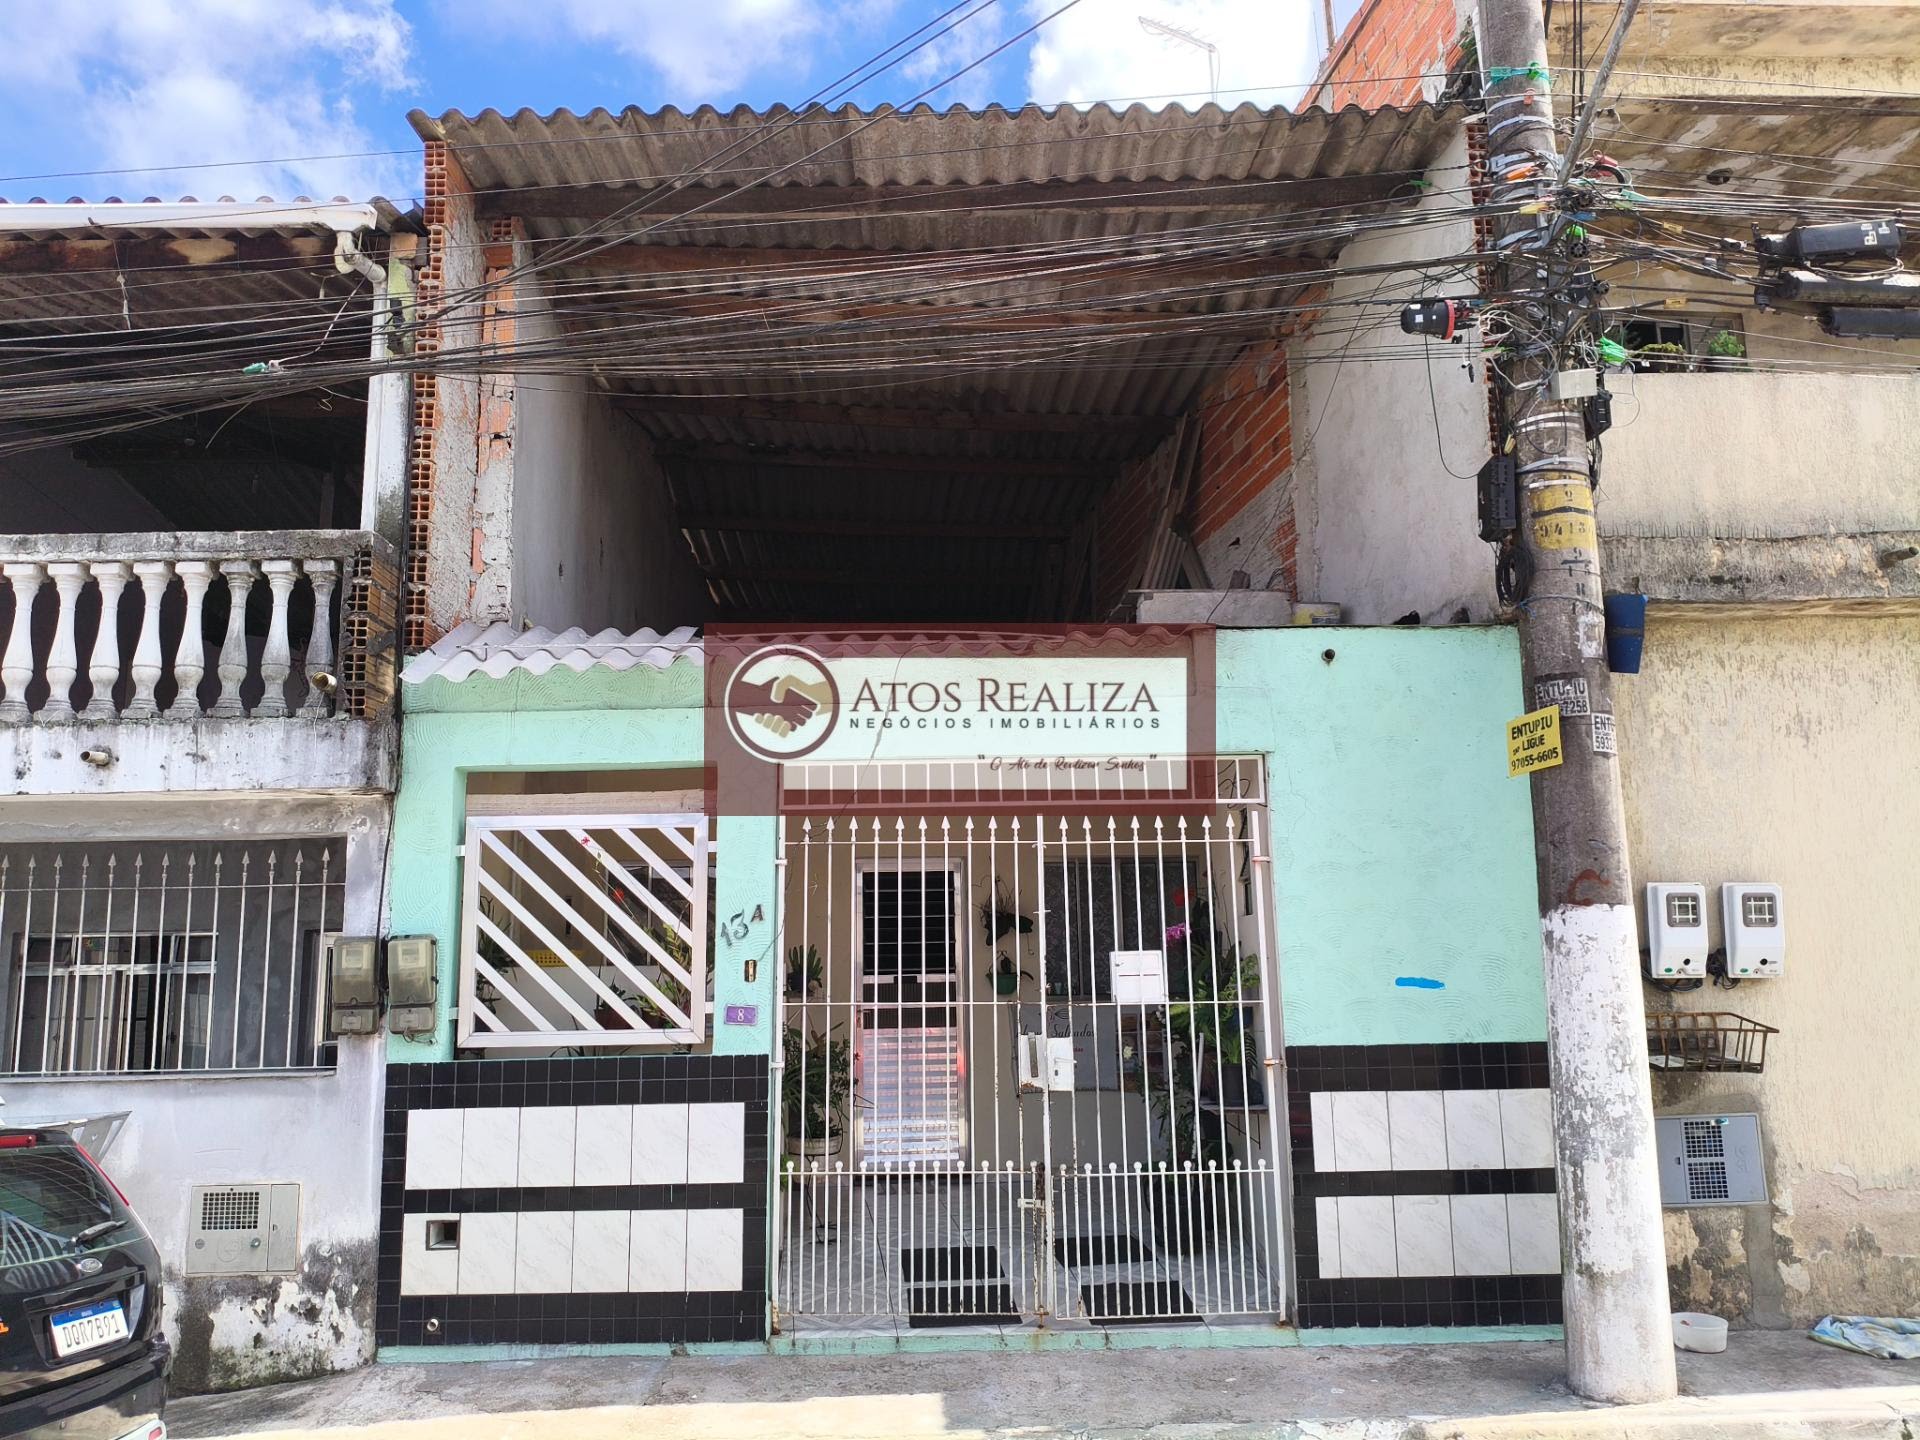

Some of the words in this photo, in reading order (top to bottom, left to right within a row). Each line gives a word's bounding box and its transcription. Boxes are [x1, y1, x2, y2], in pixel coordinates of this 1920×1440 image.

[1511, 714, 1553, 741] ENTUPIU
[1522, 734, 1545, 751] LIGUE
[1511, 746, 1559, 771] 97055-6605
[737, 1008, 745, 1022] 8
[62, 1313, 121, 1348] DQR7B91
